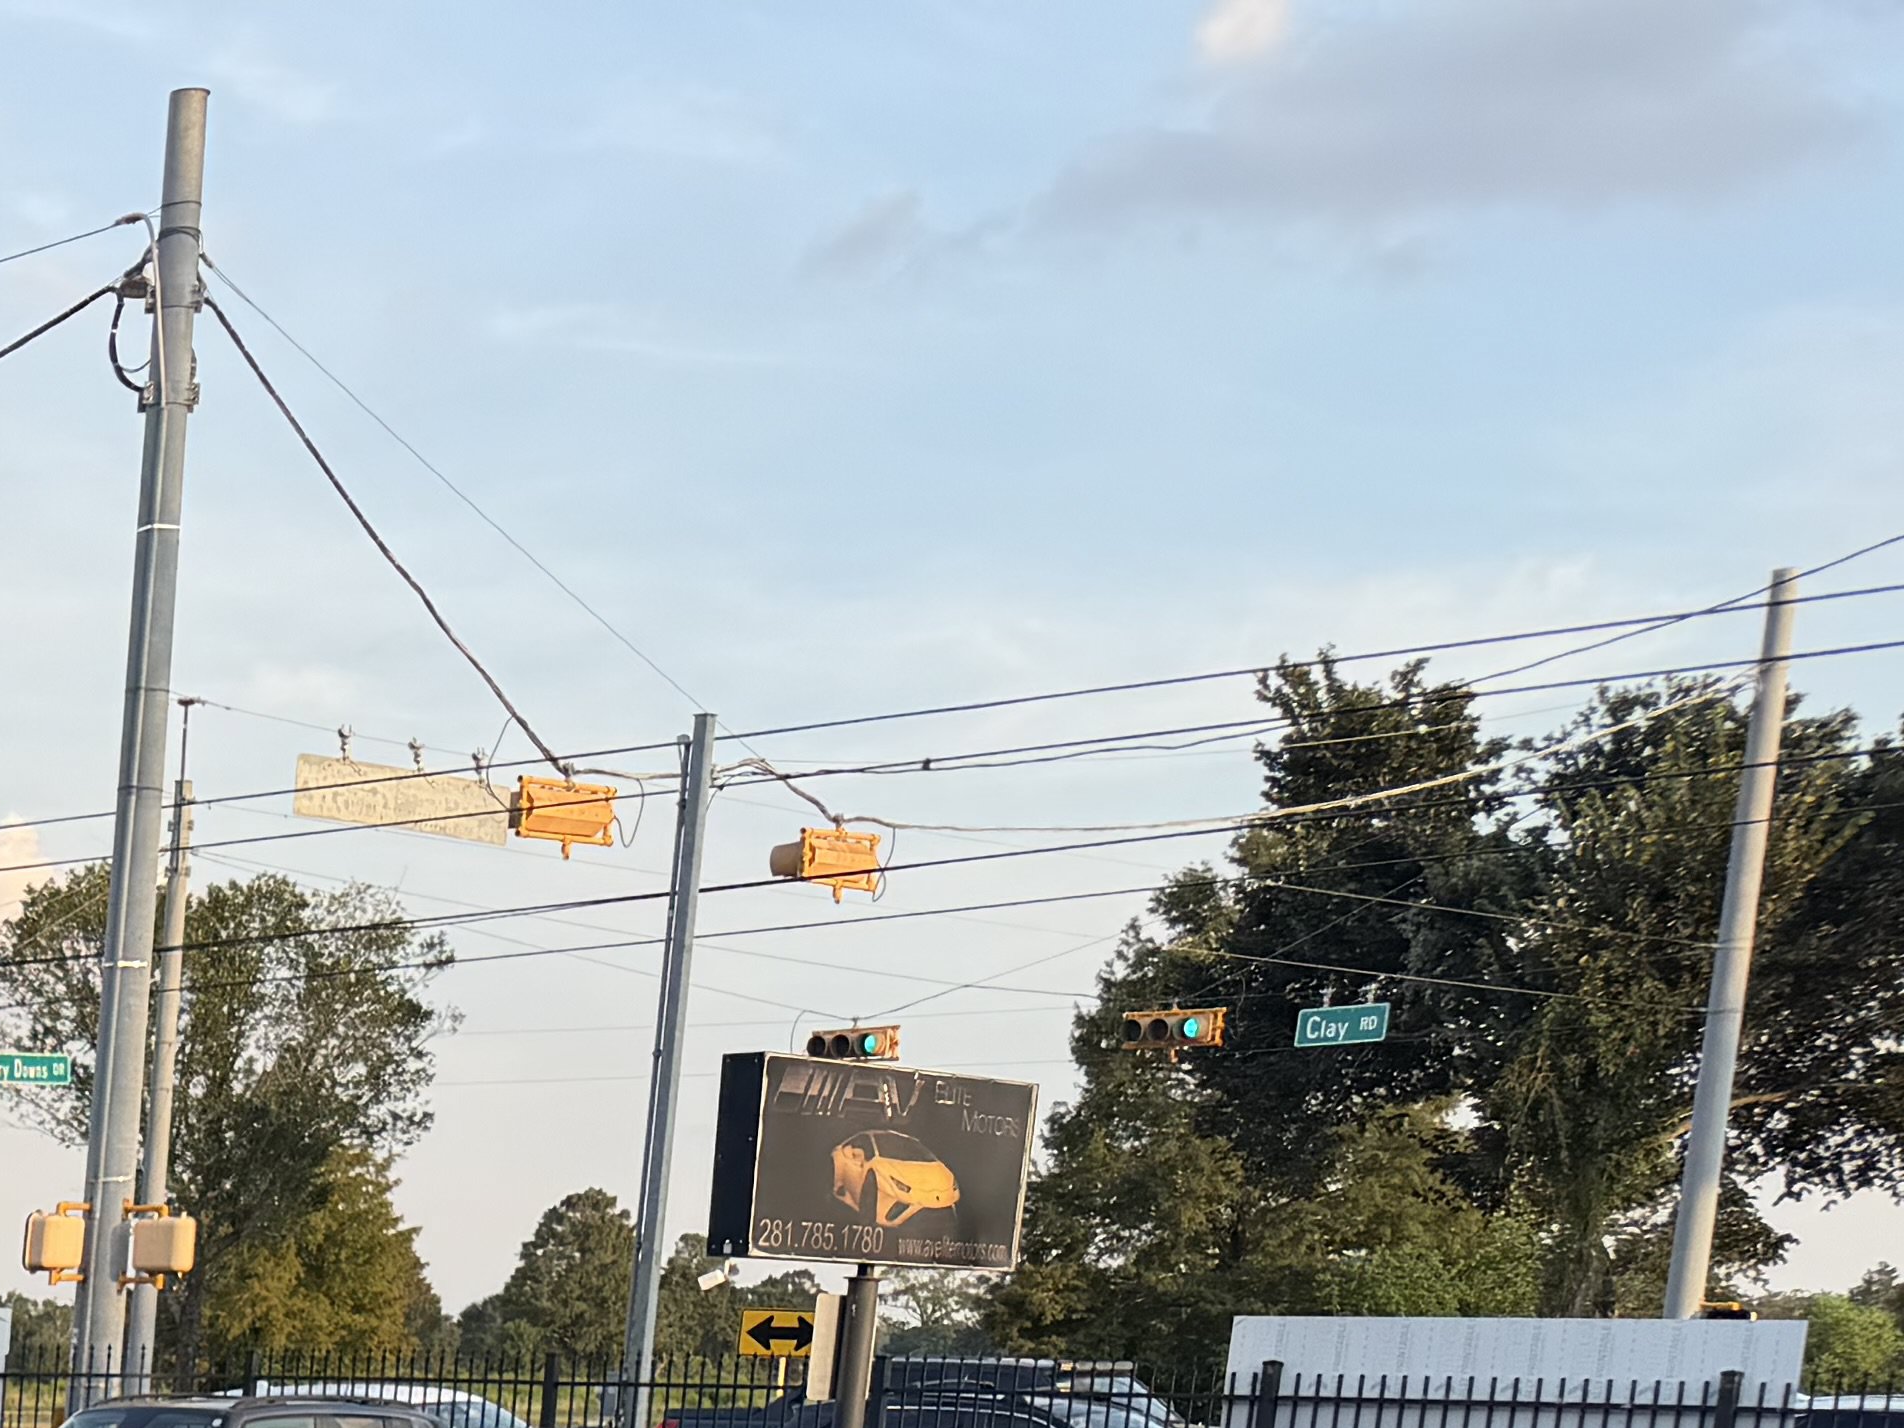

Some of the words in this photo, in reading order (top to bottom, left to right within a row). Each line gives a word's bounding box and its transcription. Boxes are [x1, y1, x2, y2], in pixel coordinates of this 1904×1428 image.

[1306, 1015, 1349, 1041] Clay
[1360, 1015, 1378, 1031] RD
[14, 1058, 49, 1079] Downs
[52, 1062, 65, 1076] DR
[758, 1218, 884, 1254] 281.785.1780
